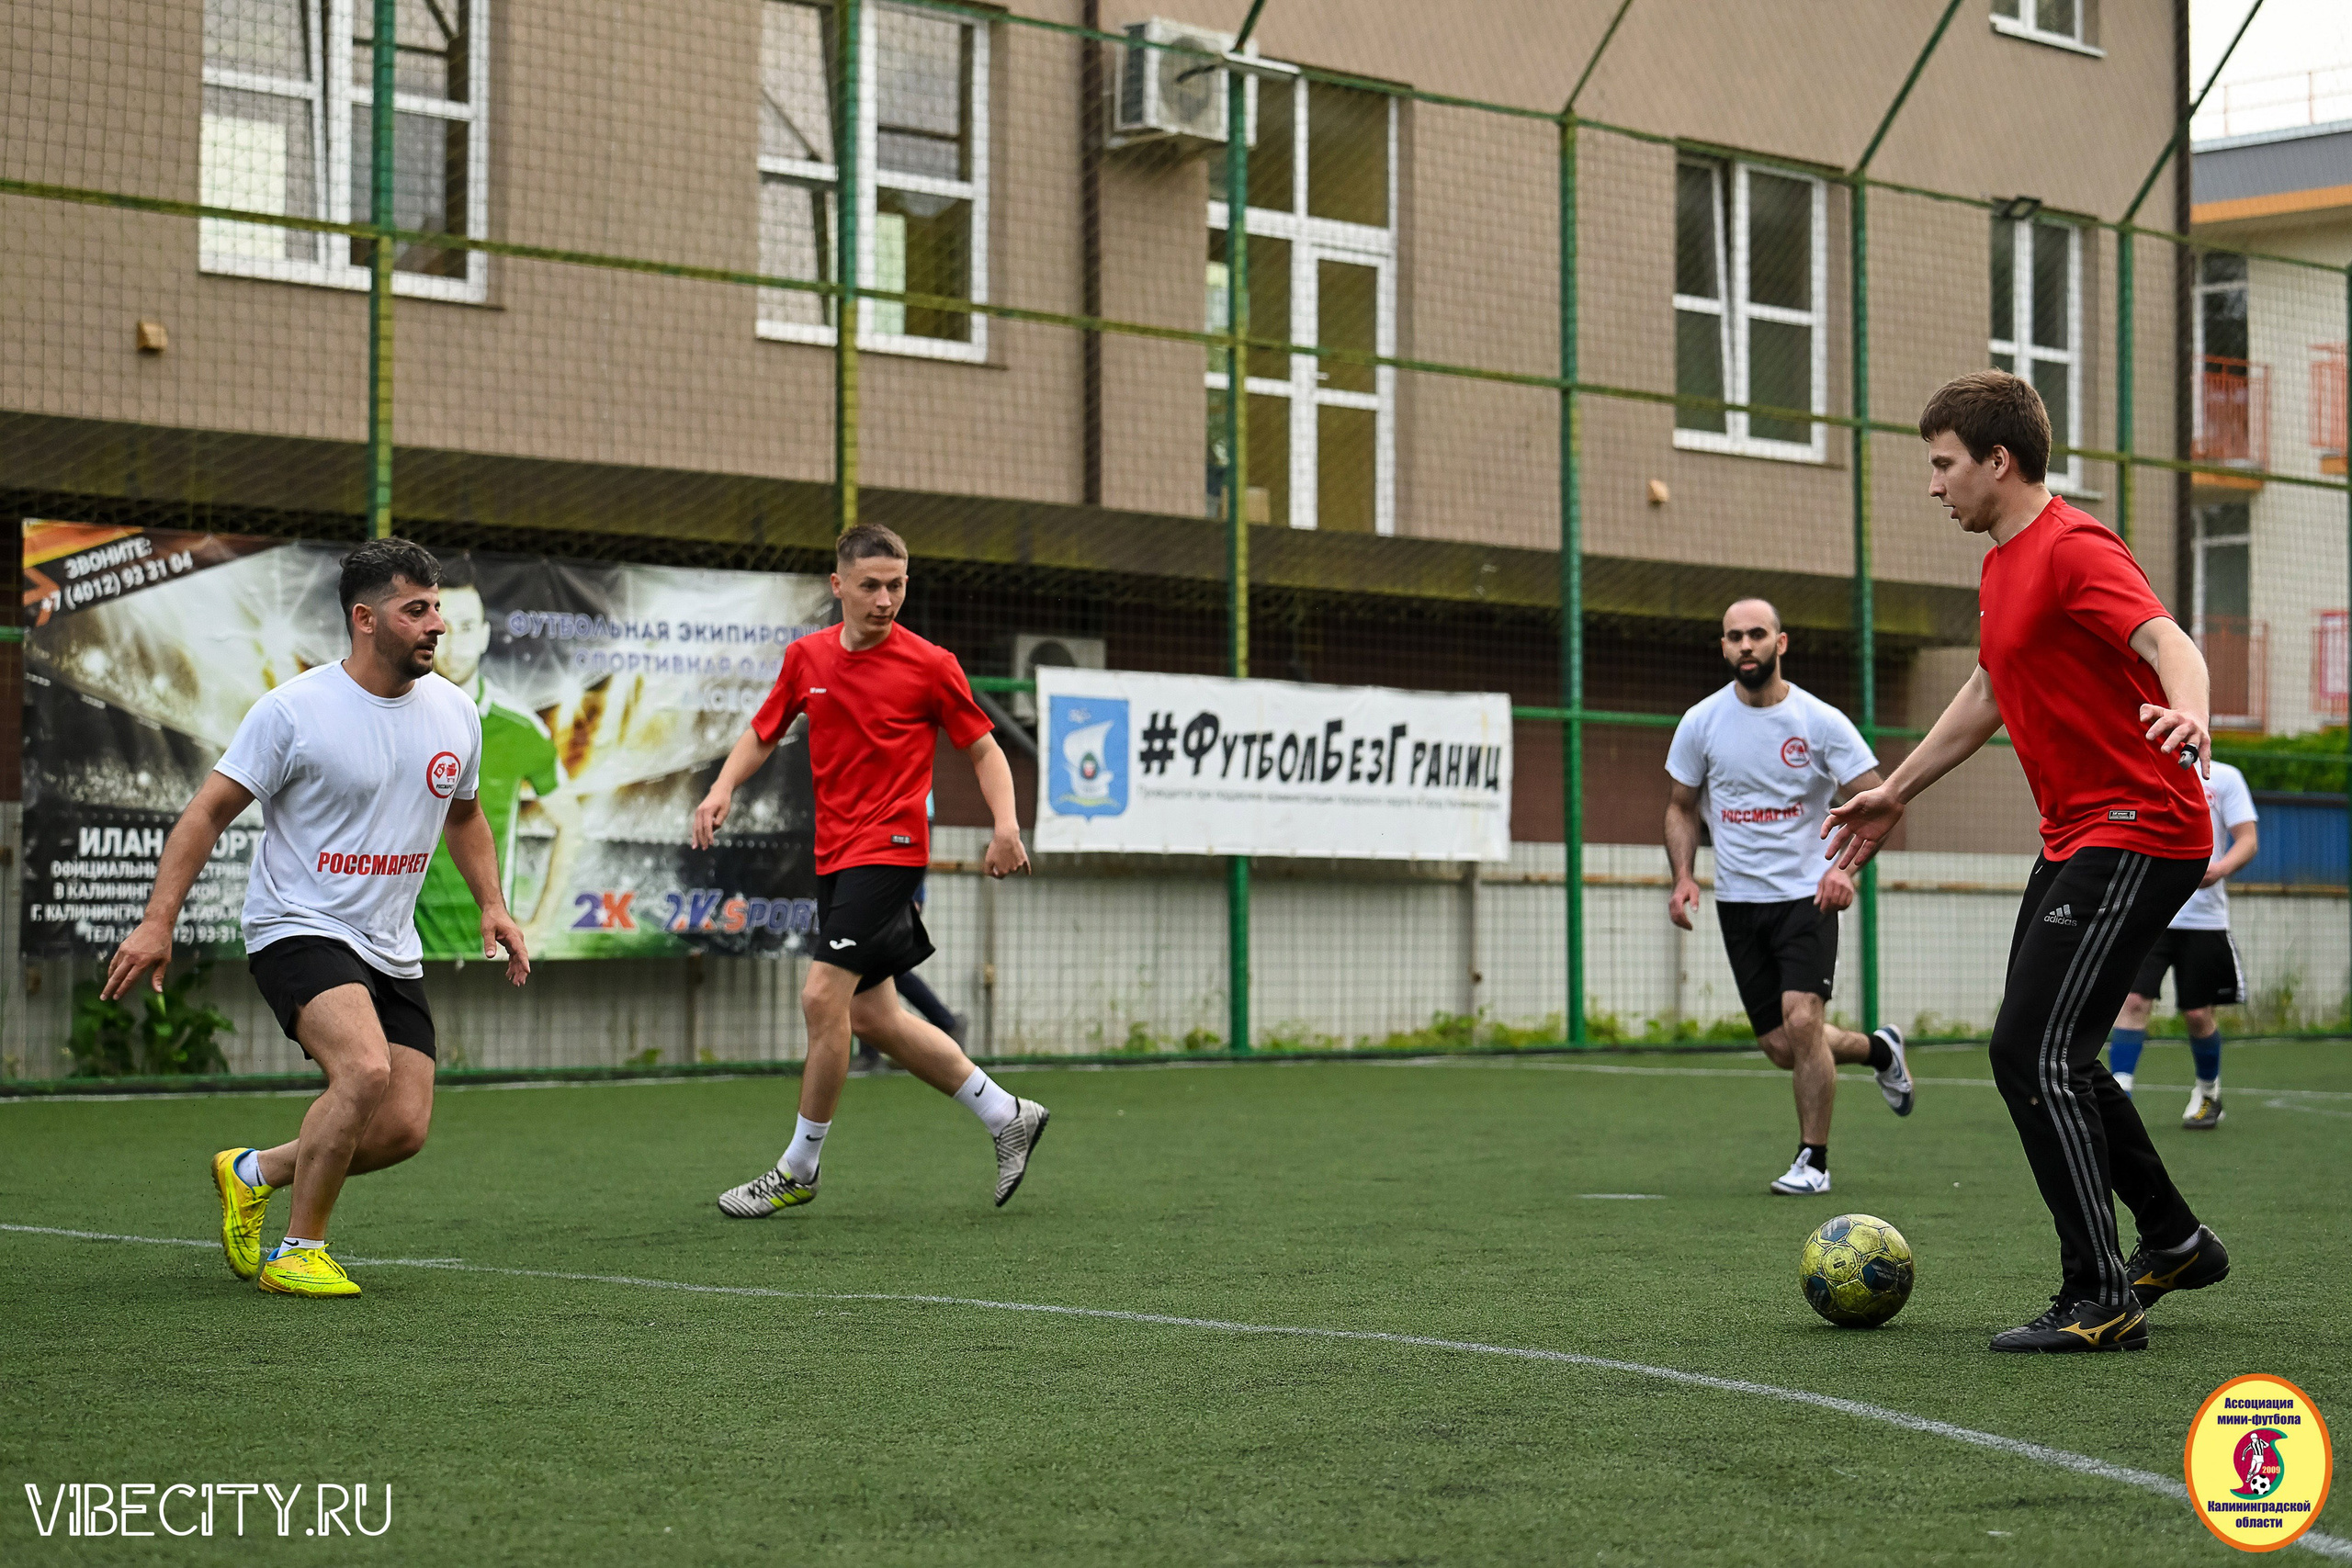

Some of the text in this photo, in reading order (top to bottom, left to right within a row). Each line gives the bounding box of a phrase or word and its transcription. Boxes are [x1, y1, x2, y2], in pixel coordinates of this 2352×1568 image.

[64, 536, 153, 579] ЗВОНИТЕ:
[64, 571, 121, 610] (4012)
[120, 564, 144, 588] 93
[144, 558, 167, 581] 31
[169, 550, 193, 573] 04
[506, 610, 670, 641] ФУТБОЛЬНАЯ
[574, 649, 732, 675] СПОРТИВНАЯ
[317, 852, 430, 876] РОССМАРКЕТ
[53, 883, 64, 899] В
[44, 904, 145, 920] КАЛИНИНГРА
[571, 889, 638, 933] 2K
[2043, 915, 2077, 926] adidas
